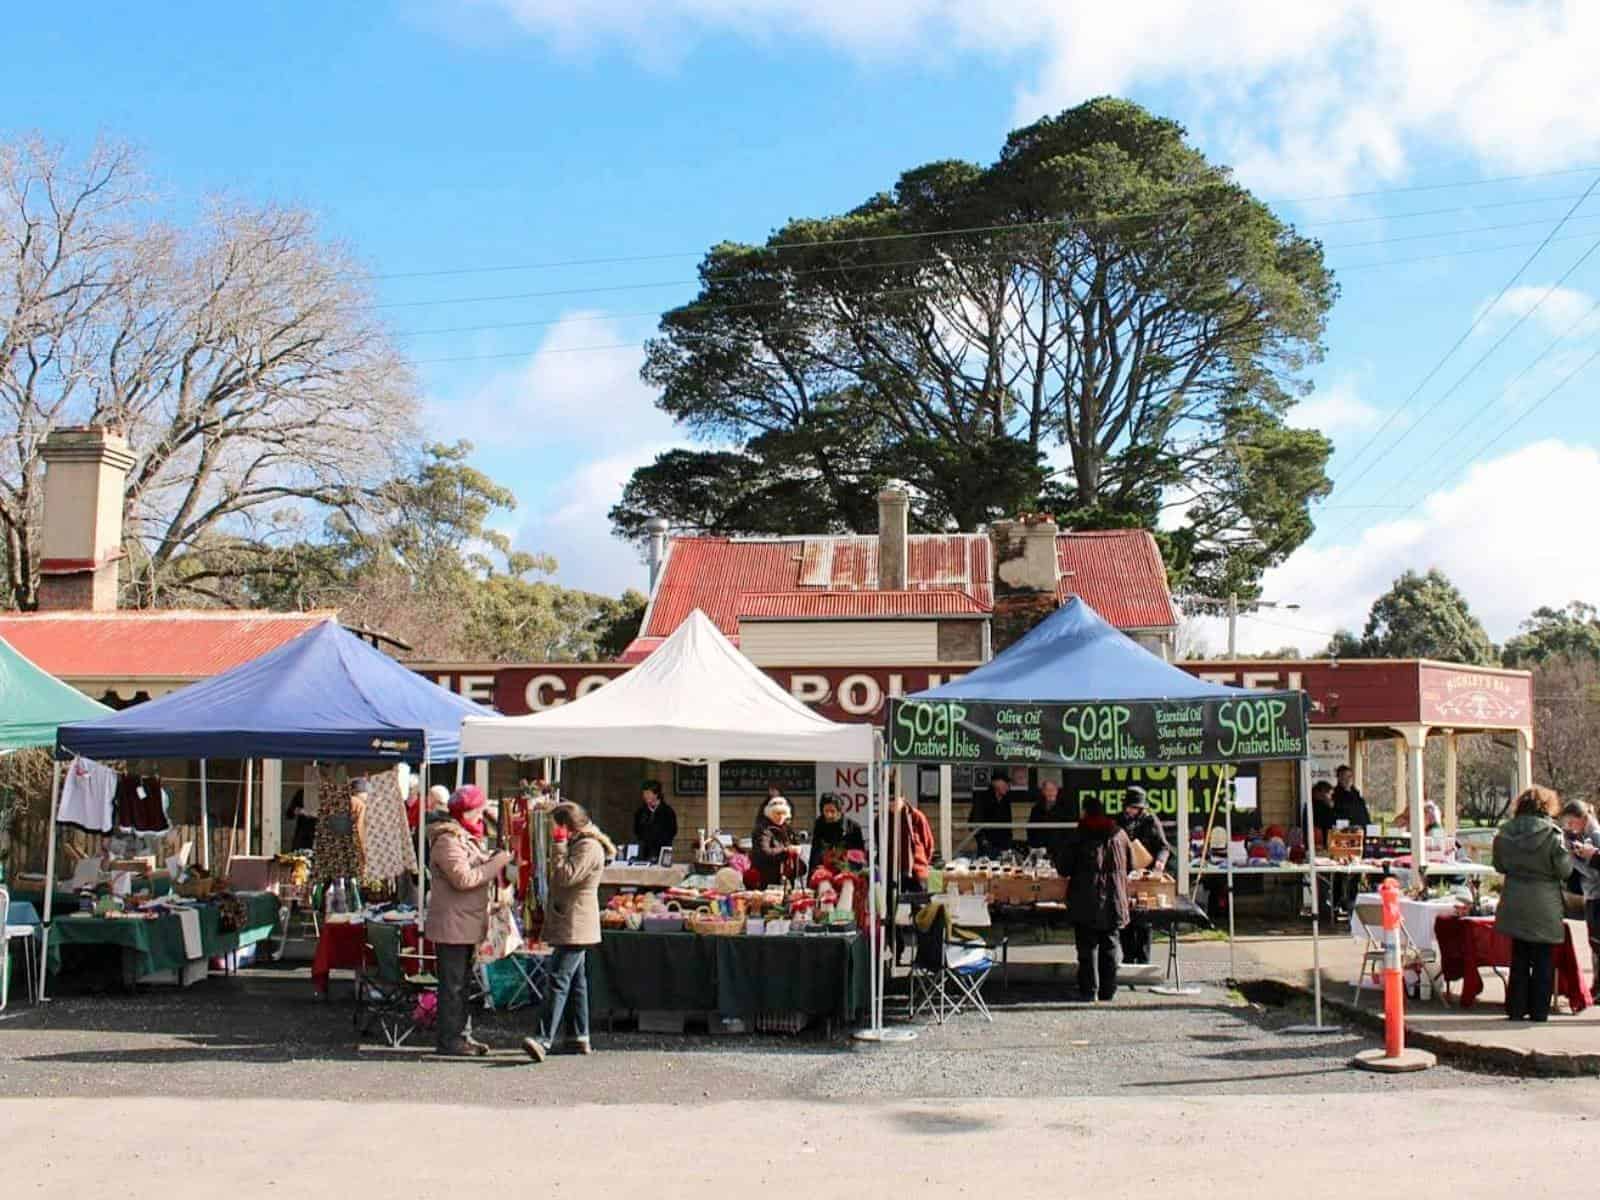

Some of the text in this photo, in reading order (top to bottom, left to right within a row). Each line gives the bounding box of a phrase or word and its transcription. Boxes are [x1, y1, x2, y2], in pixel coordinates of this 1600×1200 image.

[914, 730, 981, 758] native bliss
[1080, 732, 1145, 761] native bliss
[1238, 726, 1301, 755] native bliss
